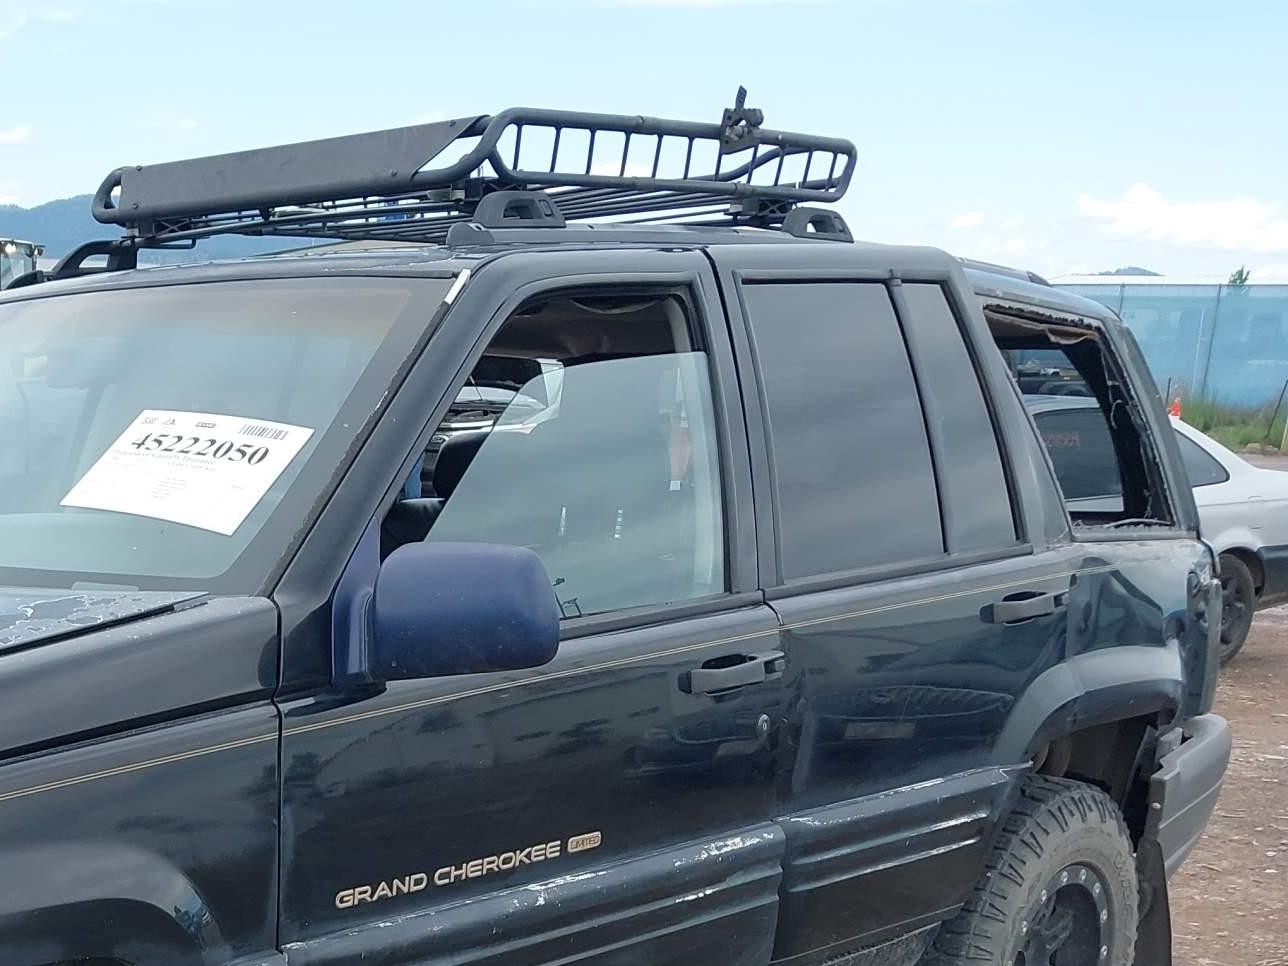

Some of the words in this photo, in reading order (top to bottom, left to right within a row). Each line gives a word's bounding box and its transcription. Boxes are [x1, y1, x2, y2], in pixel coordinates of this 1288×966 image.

[131, 432, 270, 466] 45222050
[335, 872, 428, 909] GRAND
[433, 840, 562, 886] CHEROKEE
